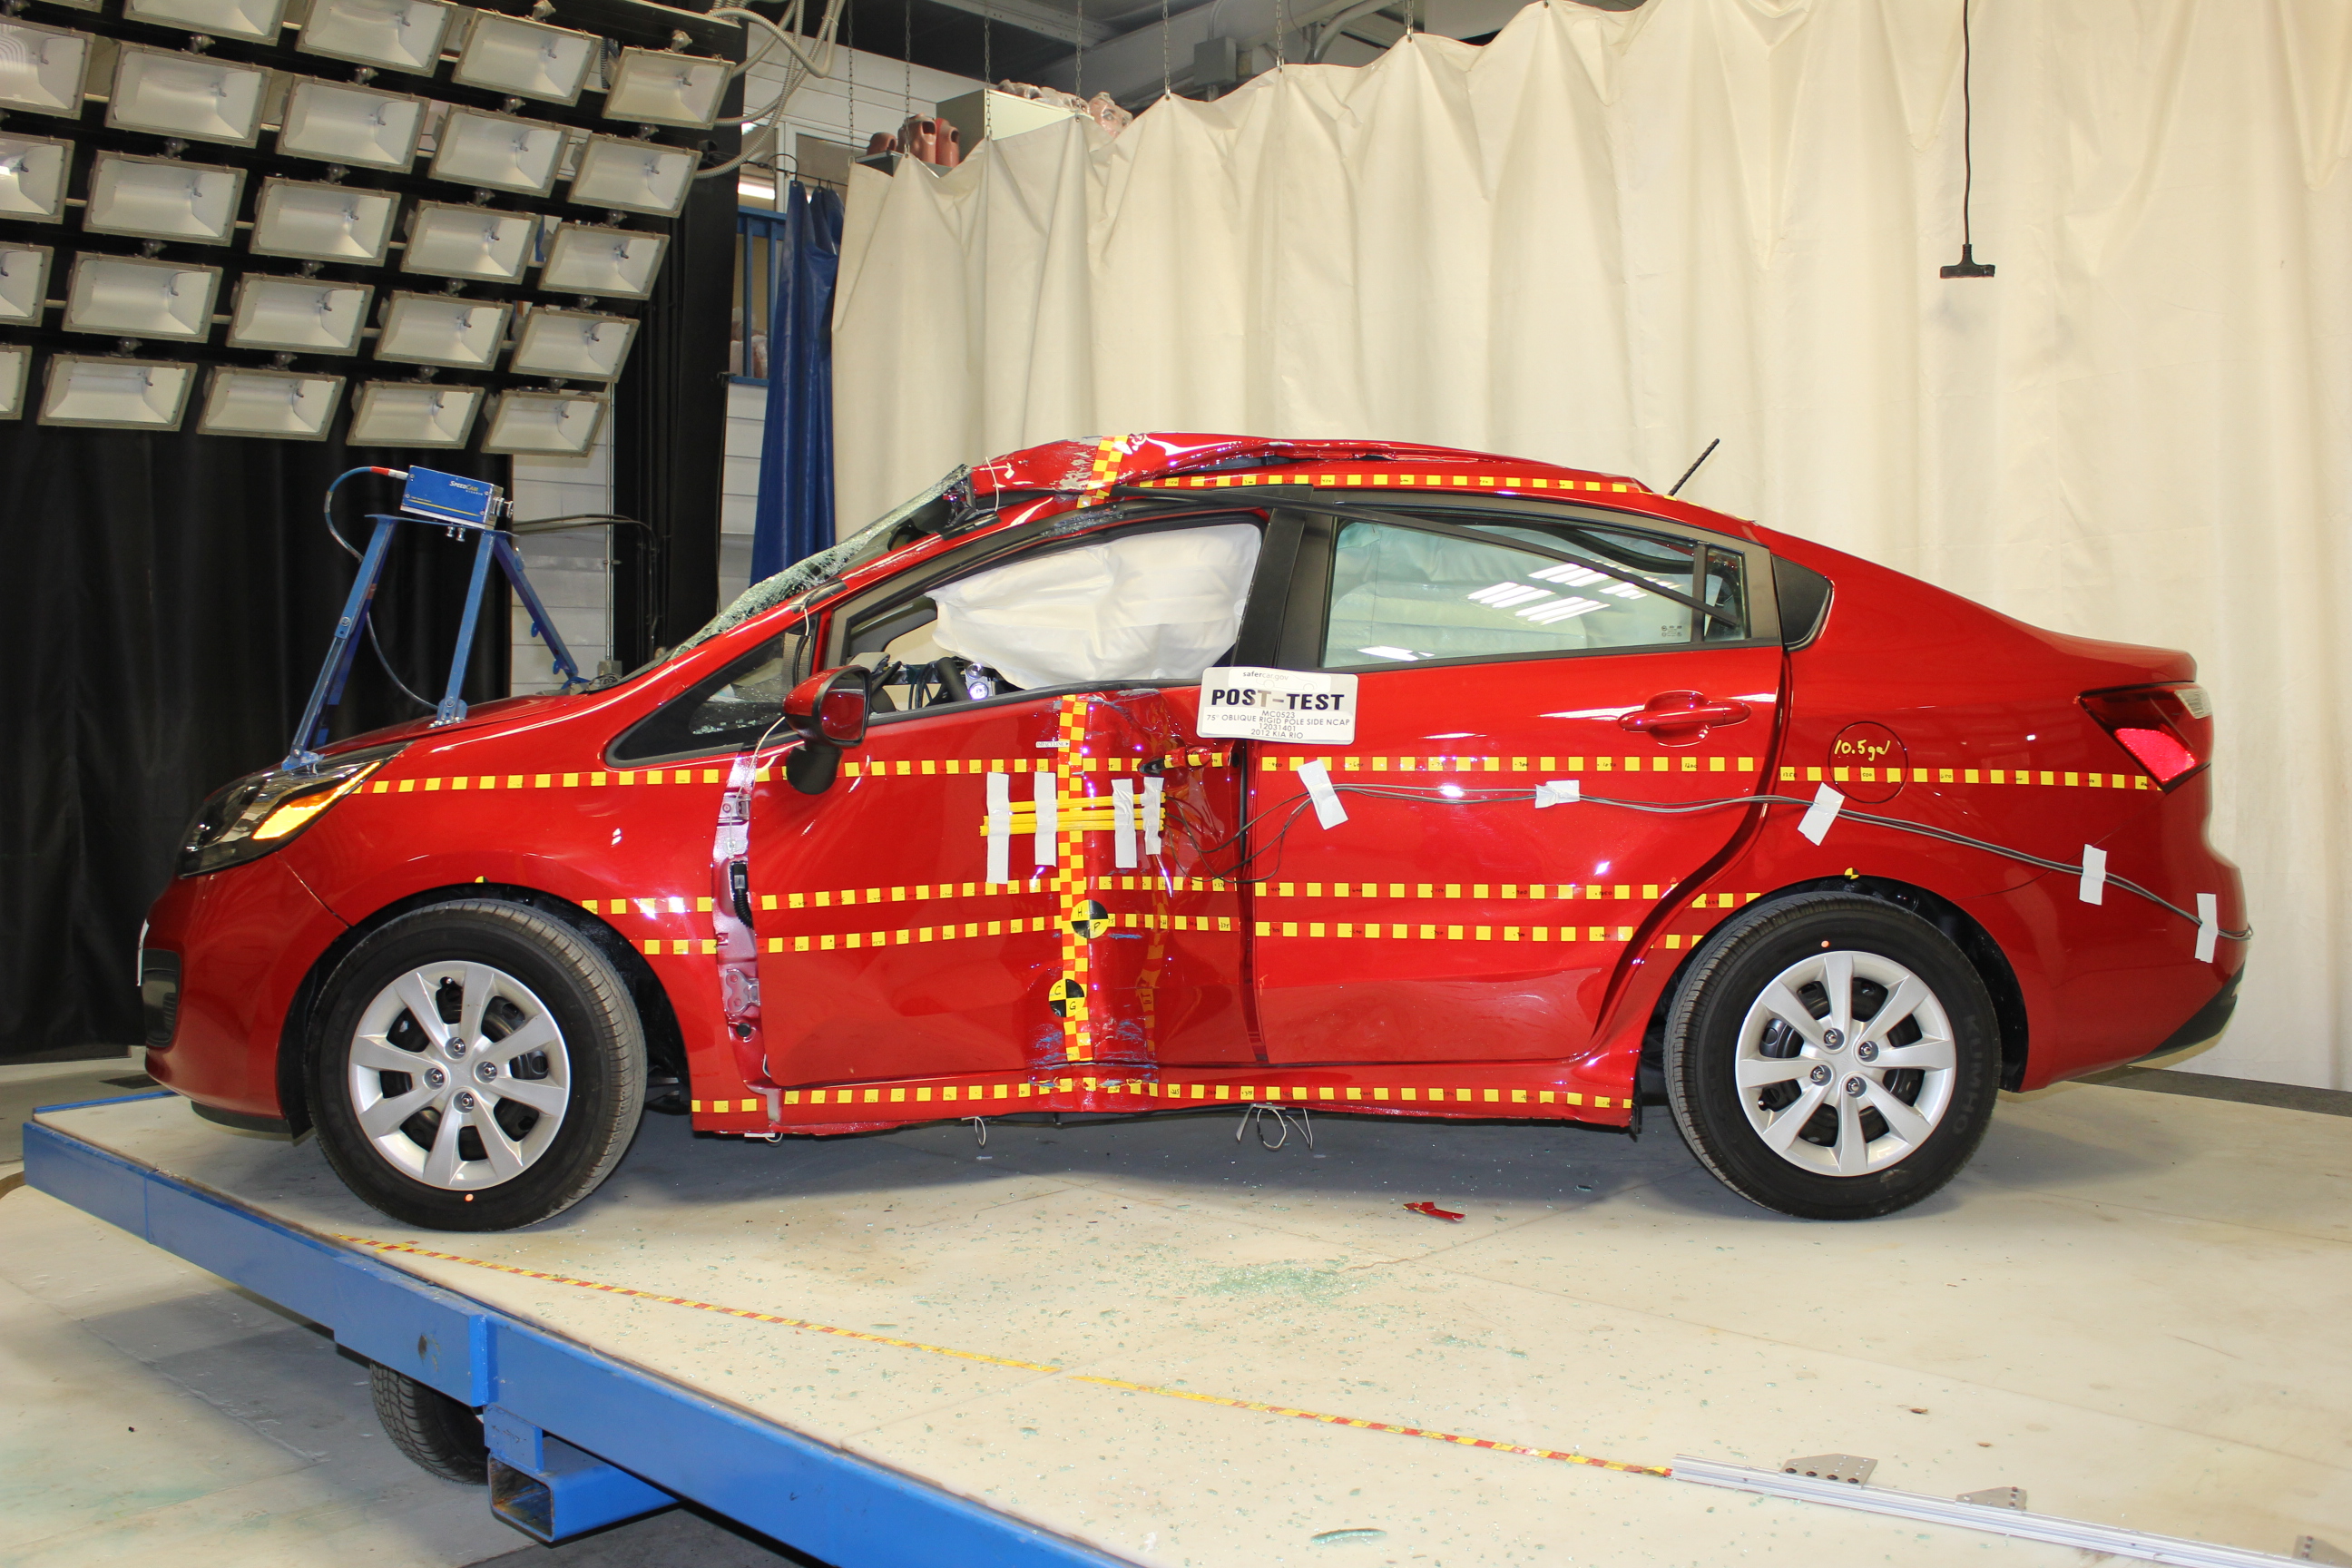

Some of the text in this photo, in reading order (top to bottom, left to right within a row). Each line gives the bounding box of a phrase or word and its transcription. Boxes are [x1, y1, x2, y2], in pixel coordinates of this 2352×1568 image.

[1242, 671, 1289, 681] safercar.gov
[1221, 714, 1257, 722] OBLIQUE
[1259, 723, 1296, 731] 12031401
[1251, 729, 1270, 737] 2012
[1289, 731, 1303, 740] RIO
[1077, 906, 1083, 917] H
[1093, 921, 1101, 932] P
[1054, 985, 1062, 995] C
[1069, 1001, 1076, 1011] G
